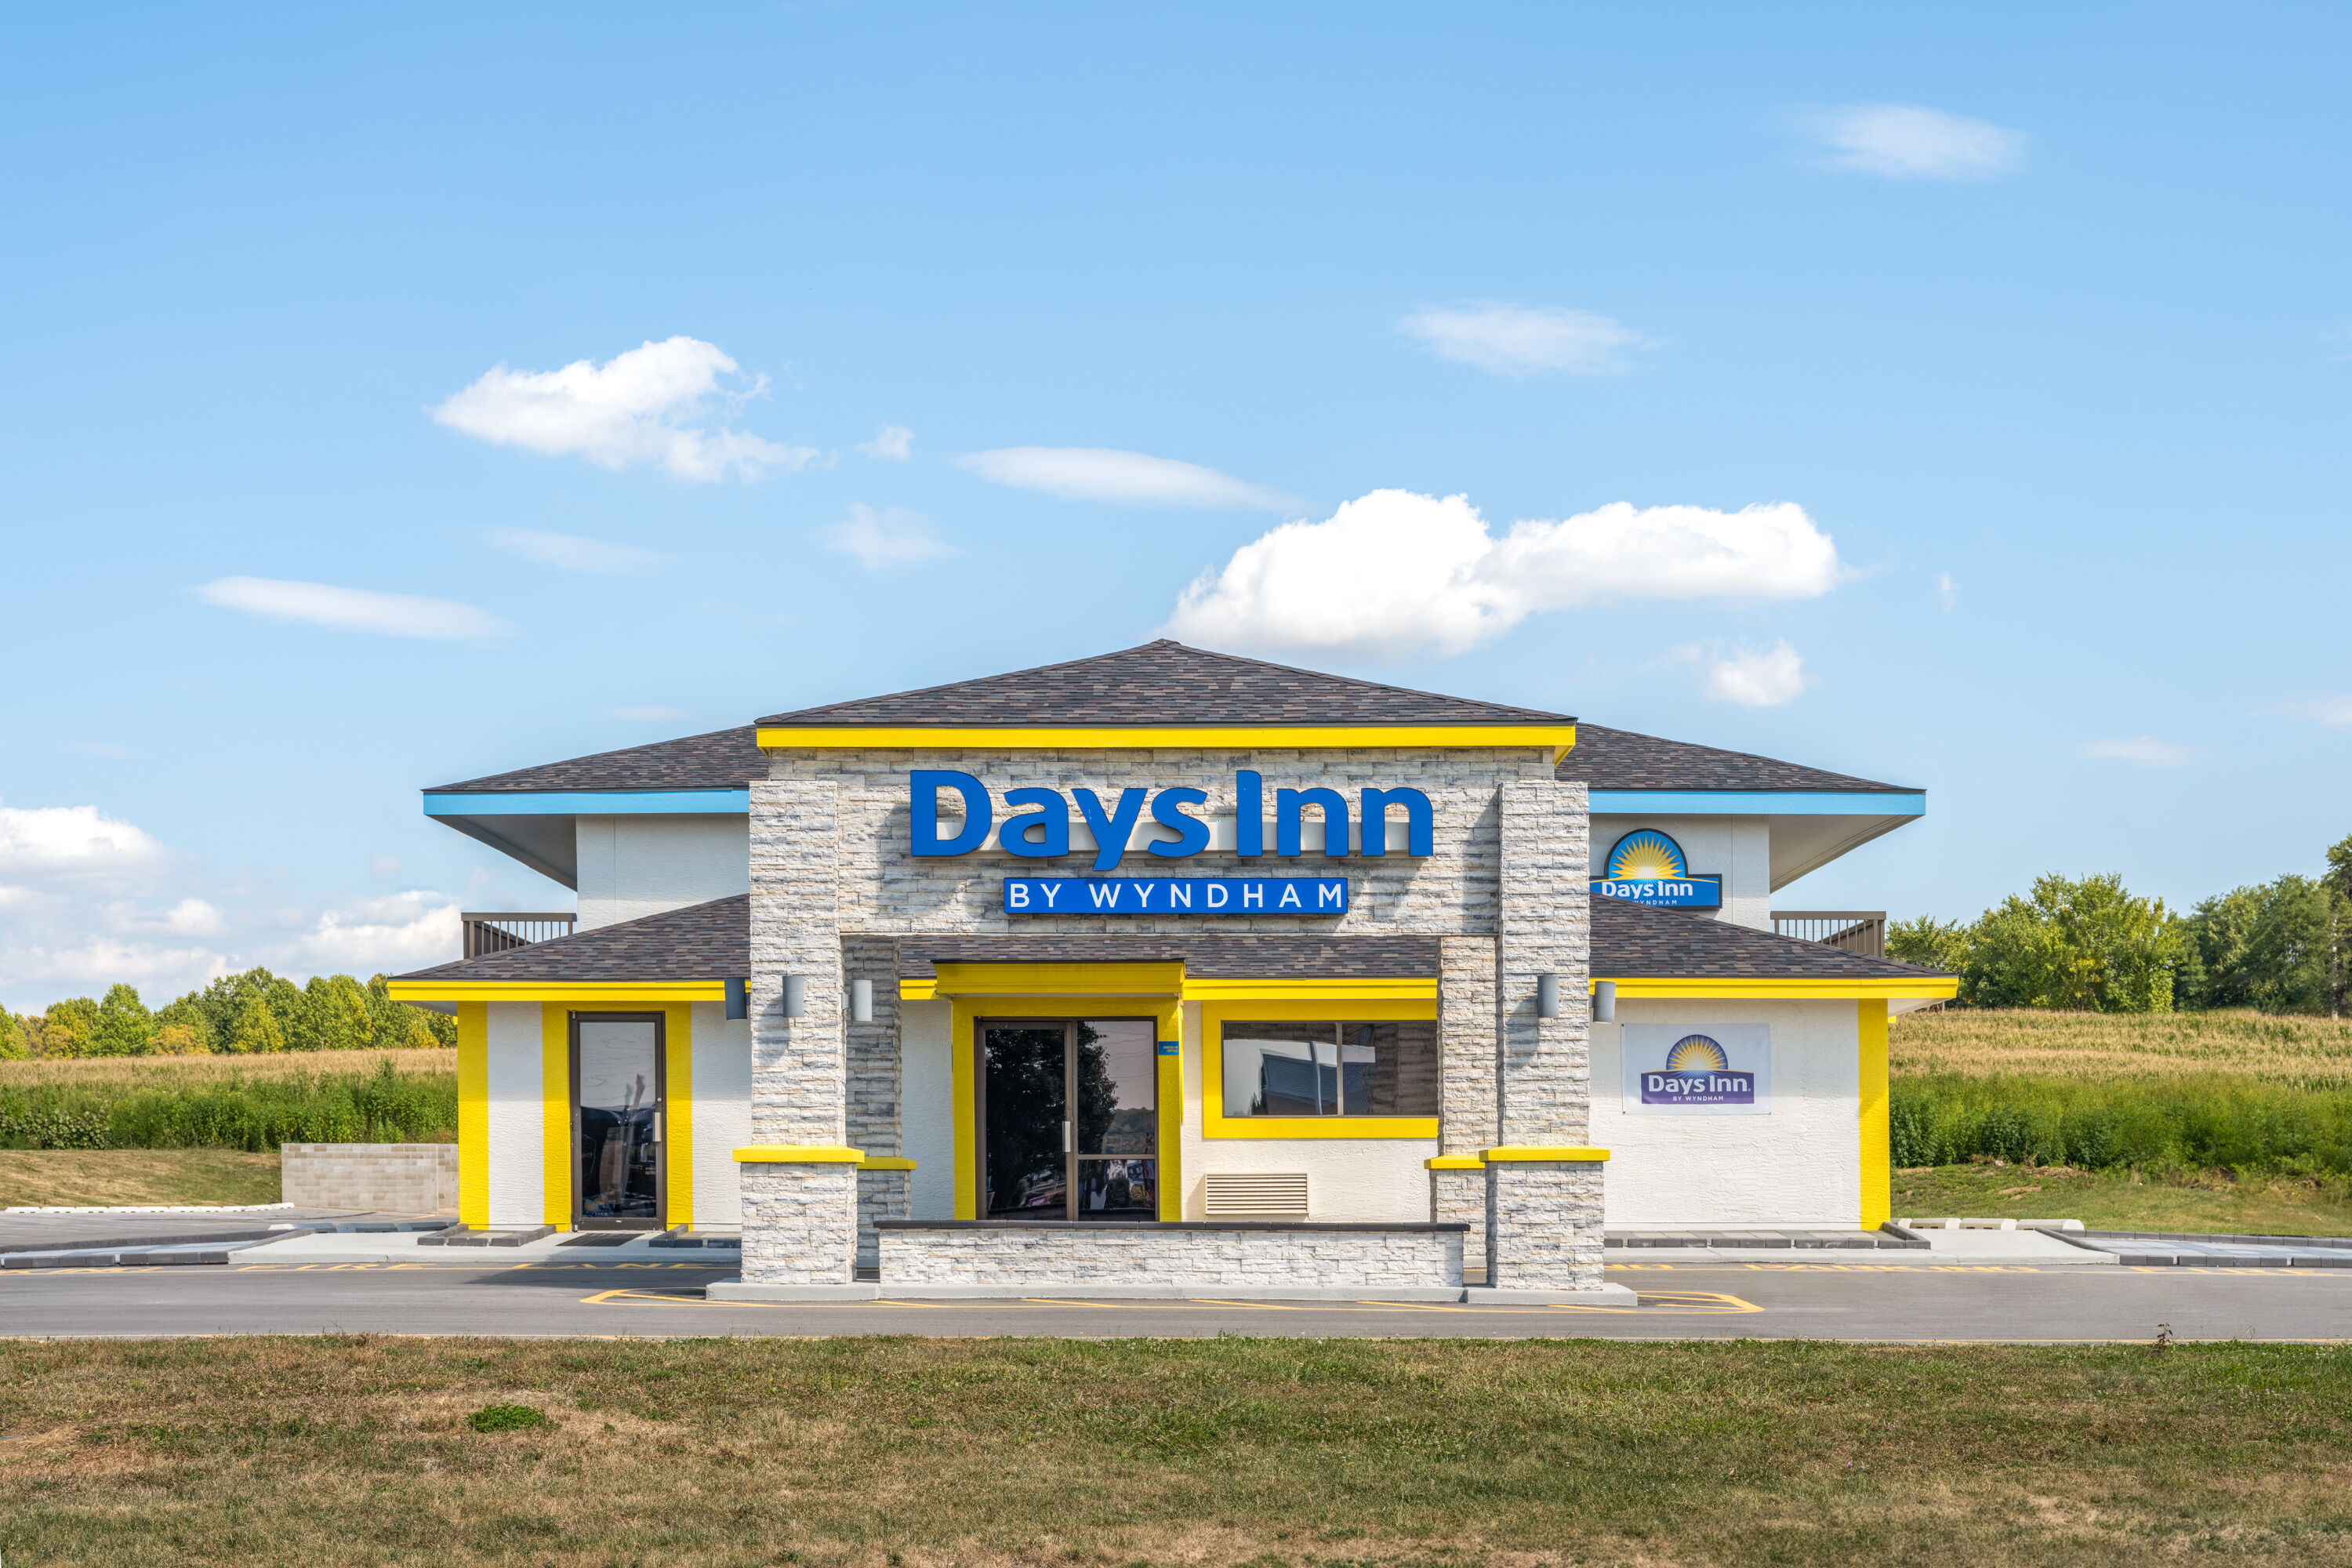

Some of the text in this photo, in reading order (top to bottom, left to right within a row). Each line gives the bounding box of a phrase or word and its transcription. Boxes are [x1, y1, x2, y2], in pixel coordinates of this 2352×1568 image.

[910, 770, 1434, 871] Days Inn
[1011, 884, 1343, 909] BY WYNDHAM
[1602, 880, 1693, 899] Days Inn
[1648, 1075, 1748, 1095] Days Inn
